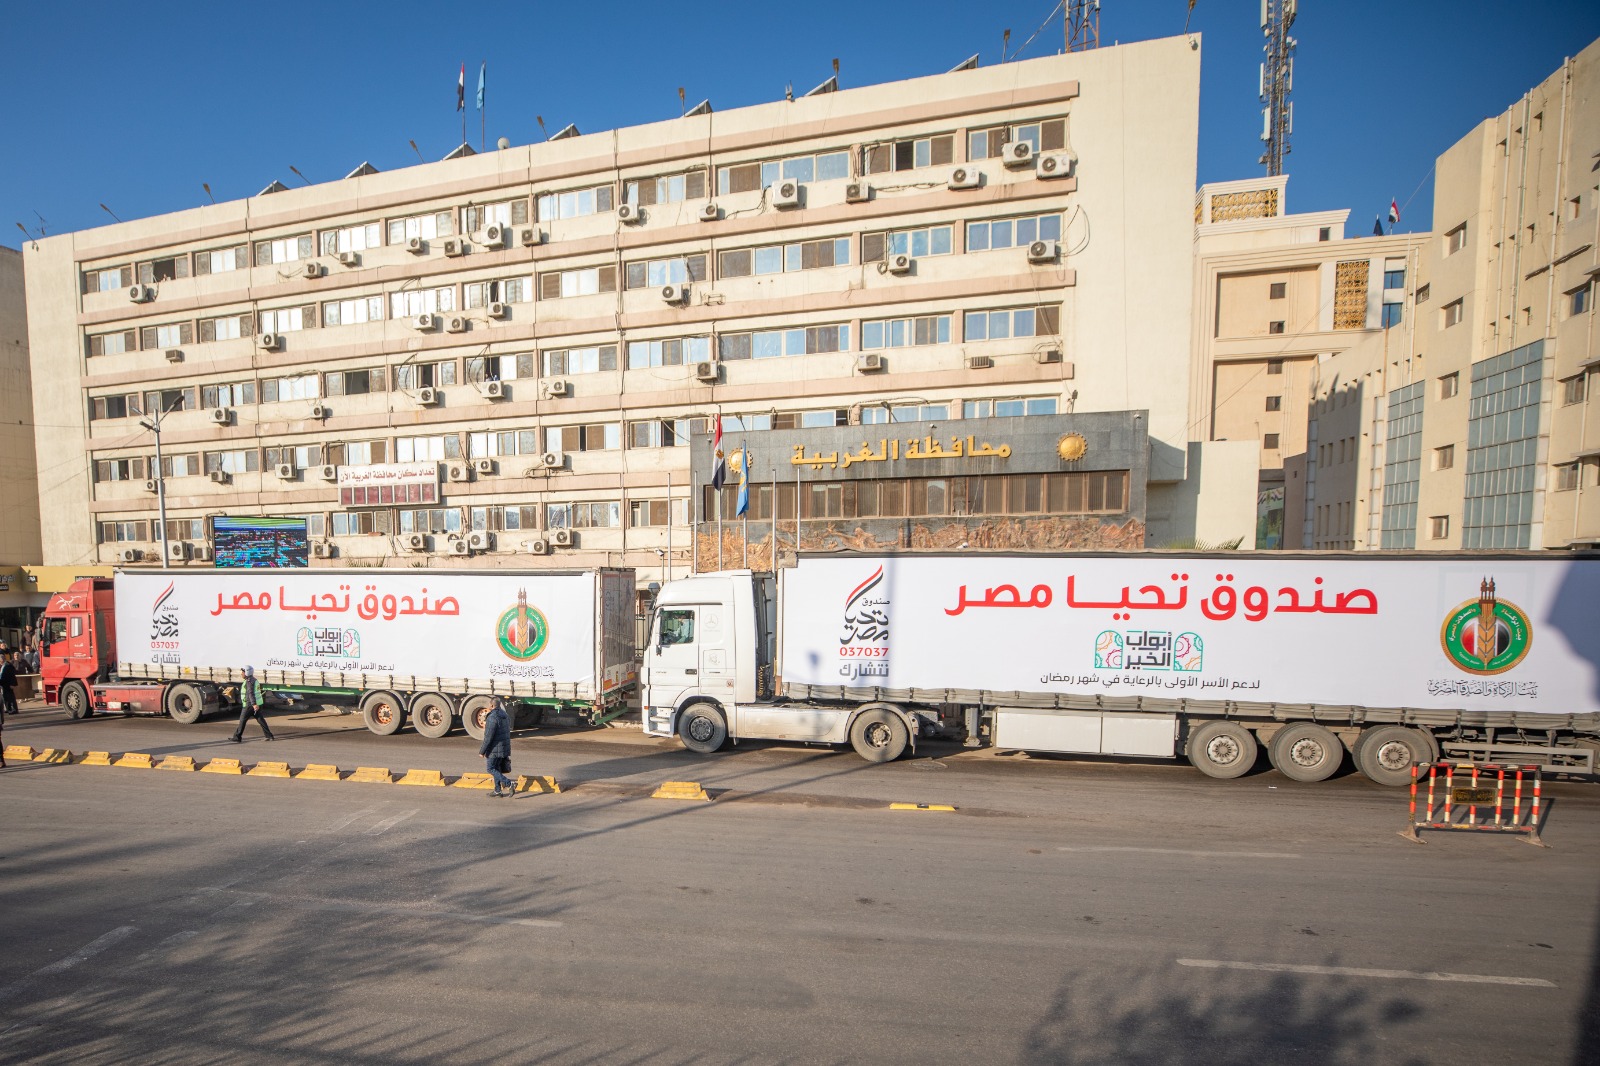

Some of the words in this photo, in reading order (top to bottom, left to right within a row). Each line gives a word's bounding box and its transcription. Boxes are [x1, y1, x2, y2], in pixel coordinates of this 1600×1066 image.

[904, 434, 1012, 459] محافظة
[790, 438, 899, 470] الغربية
[352, 472, 372, 481] الغربية
[373, 471, 396, 479] محافظة
[210, 591, 272, 616] مصر
[357, 584, 460, 621] صندوق
[943, 583, 1053, 616] مصر
[1200, 573, 1379, 622] صندوق
[315, 627, 342, 643] أبواب
[1126, 631, 1172, 651] أبواب
[151, 641, 180, 649] 037037
[315, 643, 342, 656] الخير
[840, 647, 889, 657] 037037
[151, 652, 180, 665] نتشارك
[302, 660, 314, 670] في
[1125, 652, 1171, 670] الخير
[839, 661, 889, 681] نتشارك
[1040, 672, 1075, 685] رمضان
[1076, 672, 1100, 685] شهر
[1102, 674, 1120, 689] في
[1122, 674, 1162, 687] بالرعاية
[1164, 675, 1198, 689] الأولى
[1200, 676, 1229, 690] الأسر
[1230, 679, 1261, 690] لدعم
